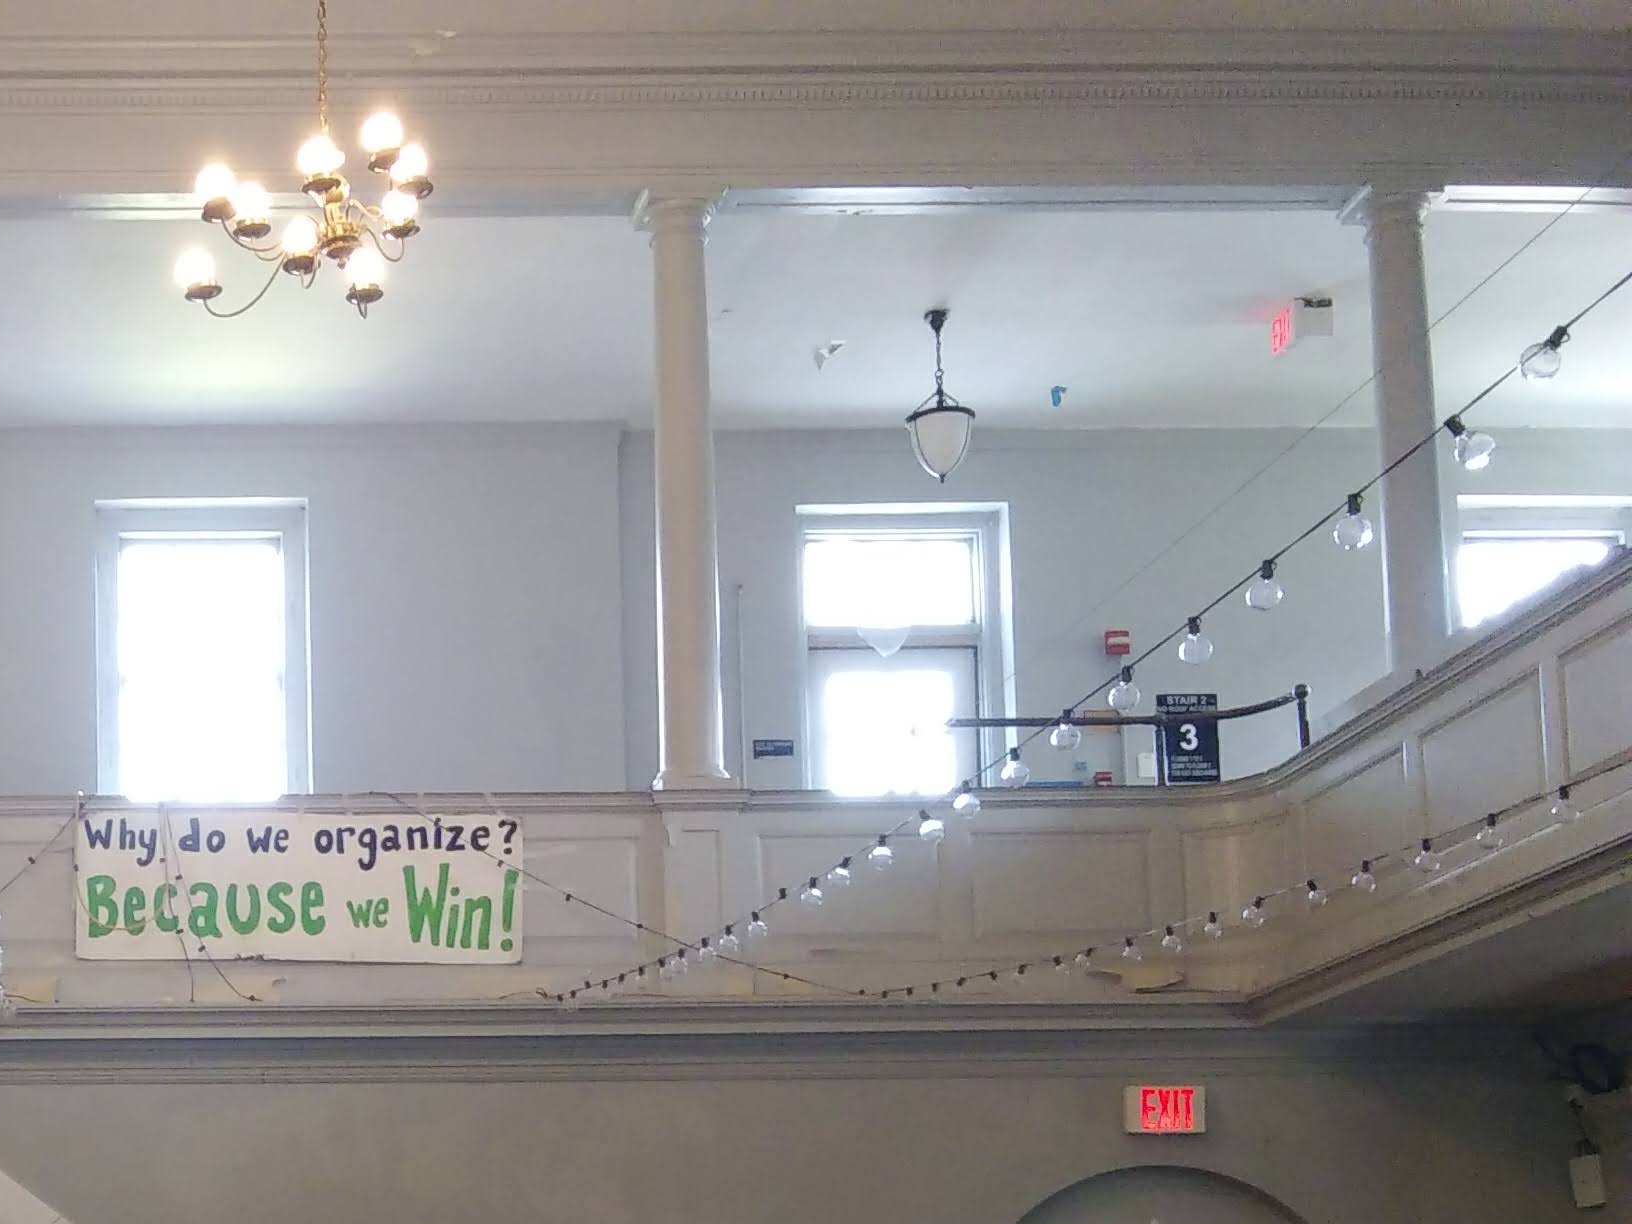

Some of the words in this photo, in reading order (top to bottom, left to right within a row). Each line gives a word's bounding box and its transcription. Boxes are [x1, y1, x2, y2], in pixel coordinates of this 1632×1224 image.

[1167, 696, 1197, 705] STAIR
[1199, 696, 1208, 705] 2
[1179, 723, 1199, 751] 3
[85, 818, 158, 866] Why
[179, 818, 226, 853] do
[247, 827, 290, 854] we
[314, 818, 518, 871] organize?
[87, 874, 327, 938] Because
[346, 896, 389, 929] we
[402, 862, 519, 952] Win!
[1142, 1088, 1194, 1129] EXIT
